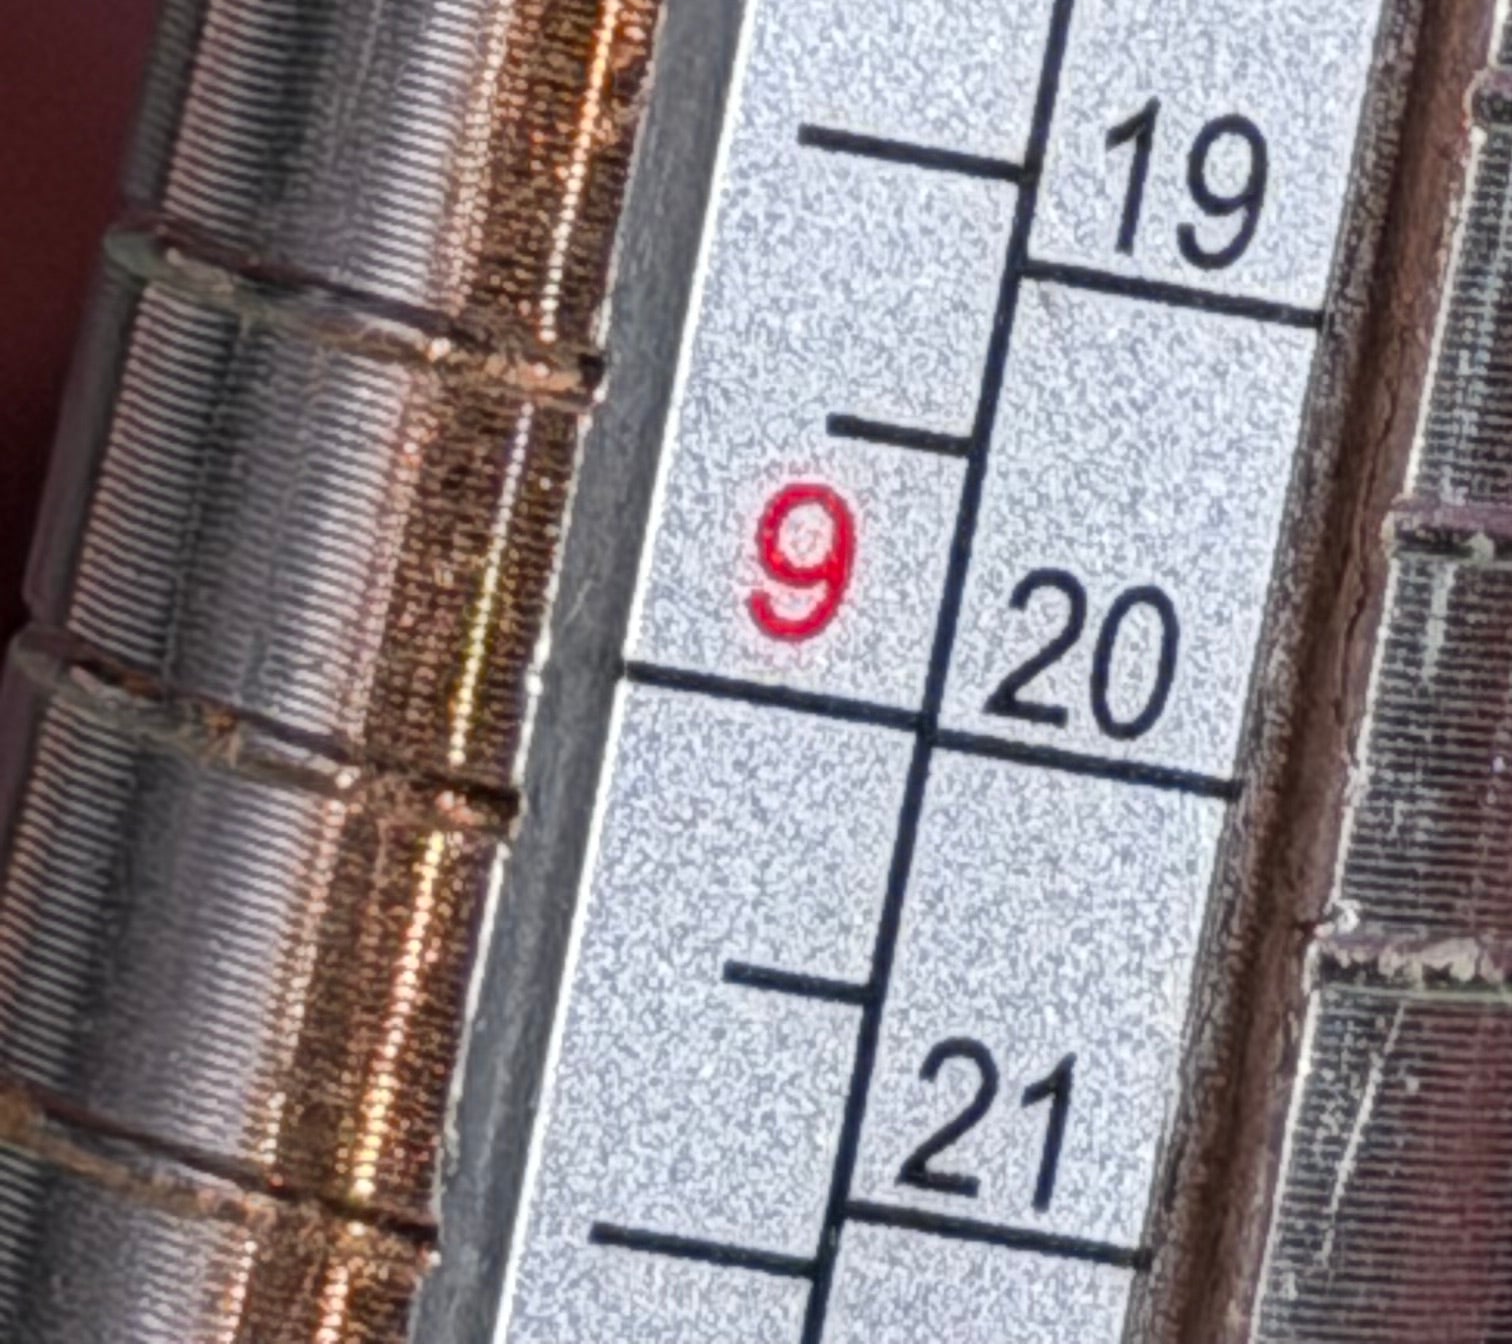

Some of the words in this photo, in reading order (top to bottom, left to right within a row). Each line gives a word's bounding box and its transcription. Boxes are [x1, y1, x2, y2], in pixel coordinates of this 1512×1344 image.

[1103, 97, 1269, 272] 19
[747, 480, 860, 646] 9
[983, 568, 1180, 742] 20
[894, 1036, 1077, 1212] 21
